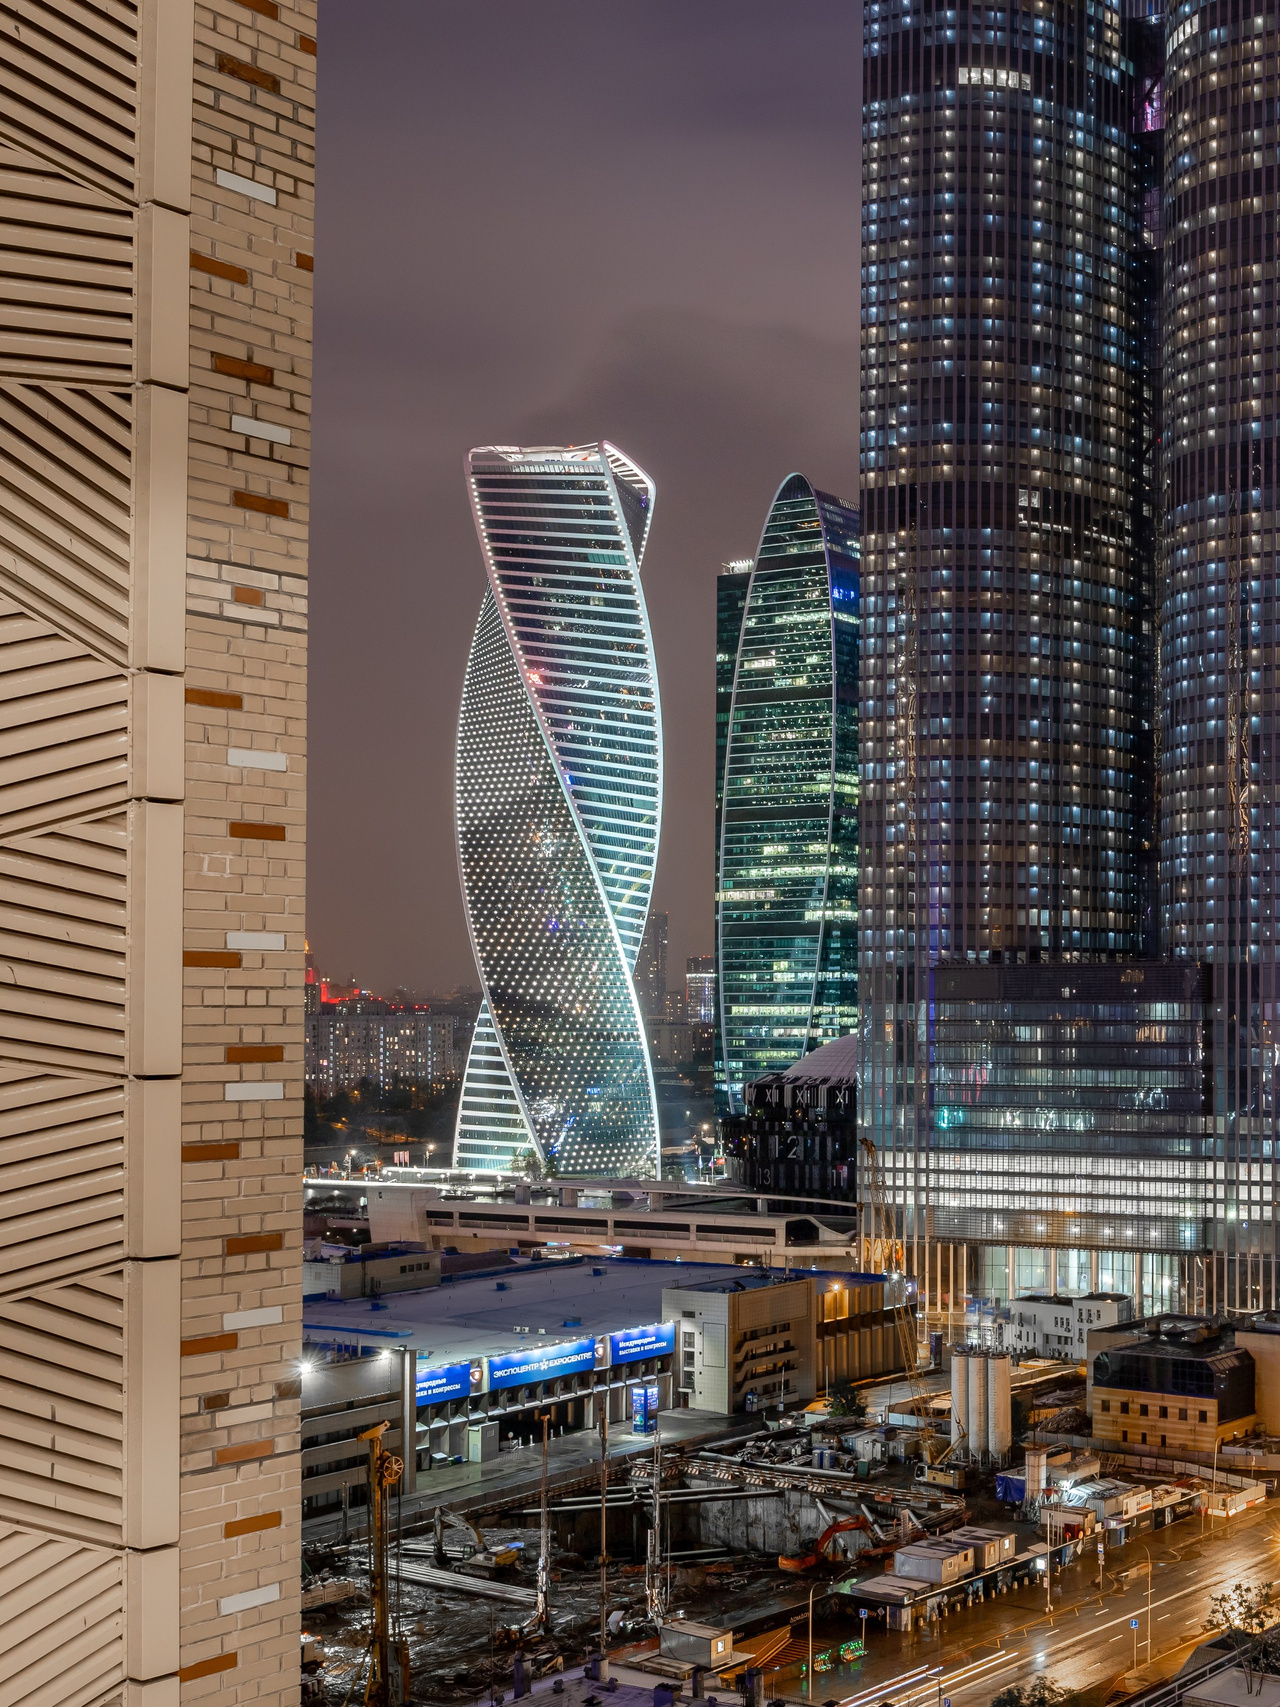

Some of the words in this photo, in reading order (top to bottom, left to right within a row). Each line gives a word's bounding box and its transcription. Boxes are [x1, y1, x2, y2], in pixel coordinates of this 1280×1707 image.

[774, 1135, 798, 1158] 12
[759, 1168, 771, 1185] 13
[832, 1169, 844, 1186] 11
[549, 1352, 593, 1367] EXPOCENTRE
[493, 1363, 539, 1378] ЭКСПОЦЕНТР
[416, 1378, 447, 1390] ународные
[433, 1383, 461, 1393] конгрессы
